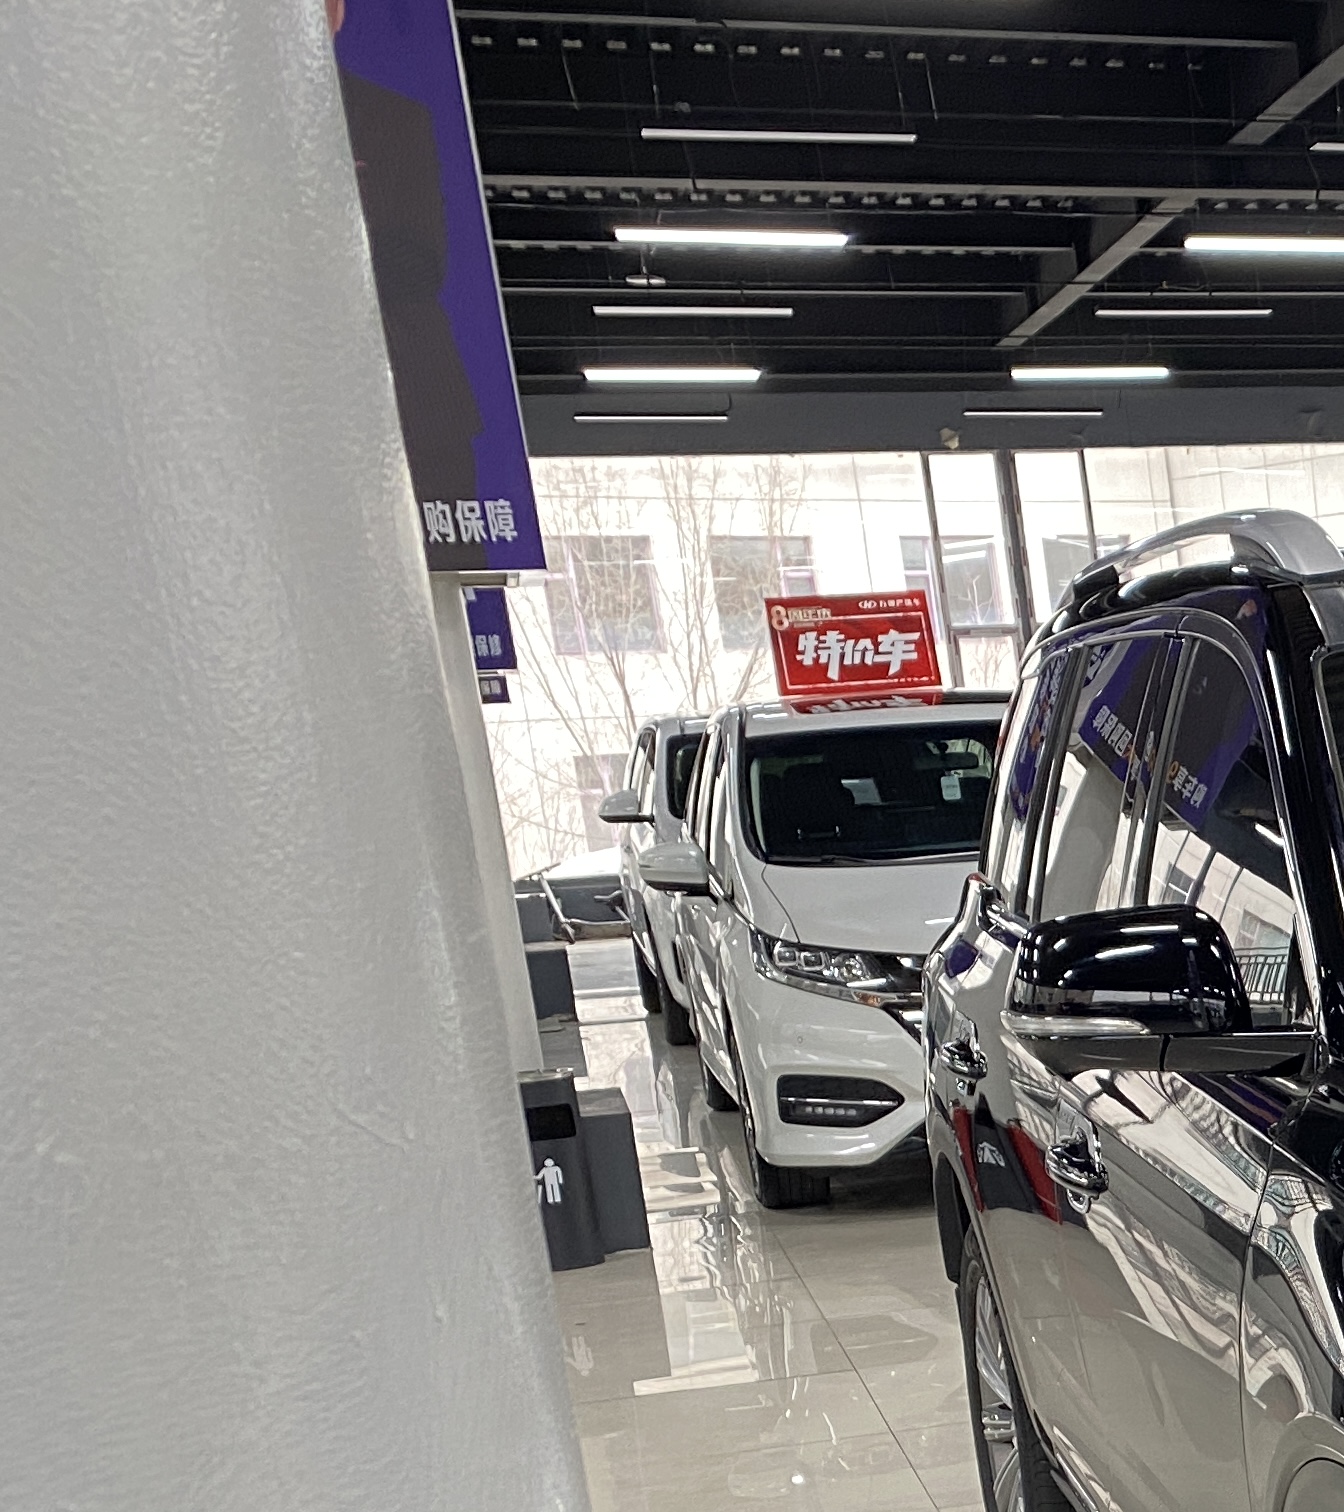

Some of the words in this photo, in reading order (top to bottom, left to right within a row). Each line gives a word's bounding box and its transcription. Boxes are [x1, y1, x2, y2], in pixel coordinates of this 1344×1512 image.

[422, 498, 519, 544] 购保障
[796, 628, 921, 682] 特价车
